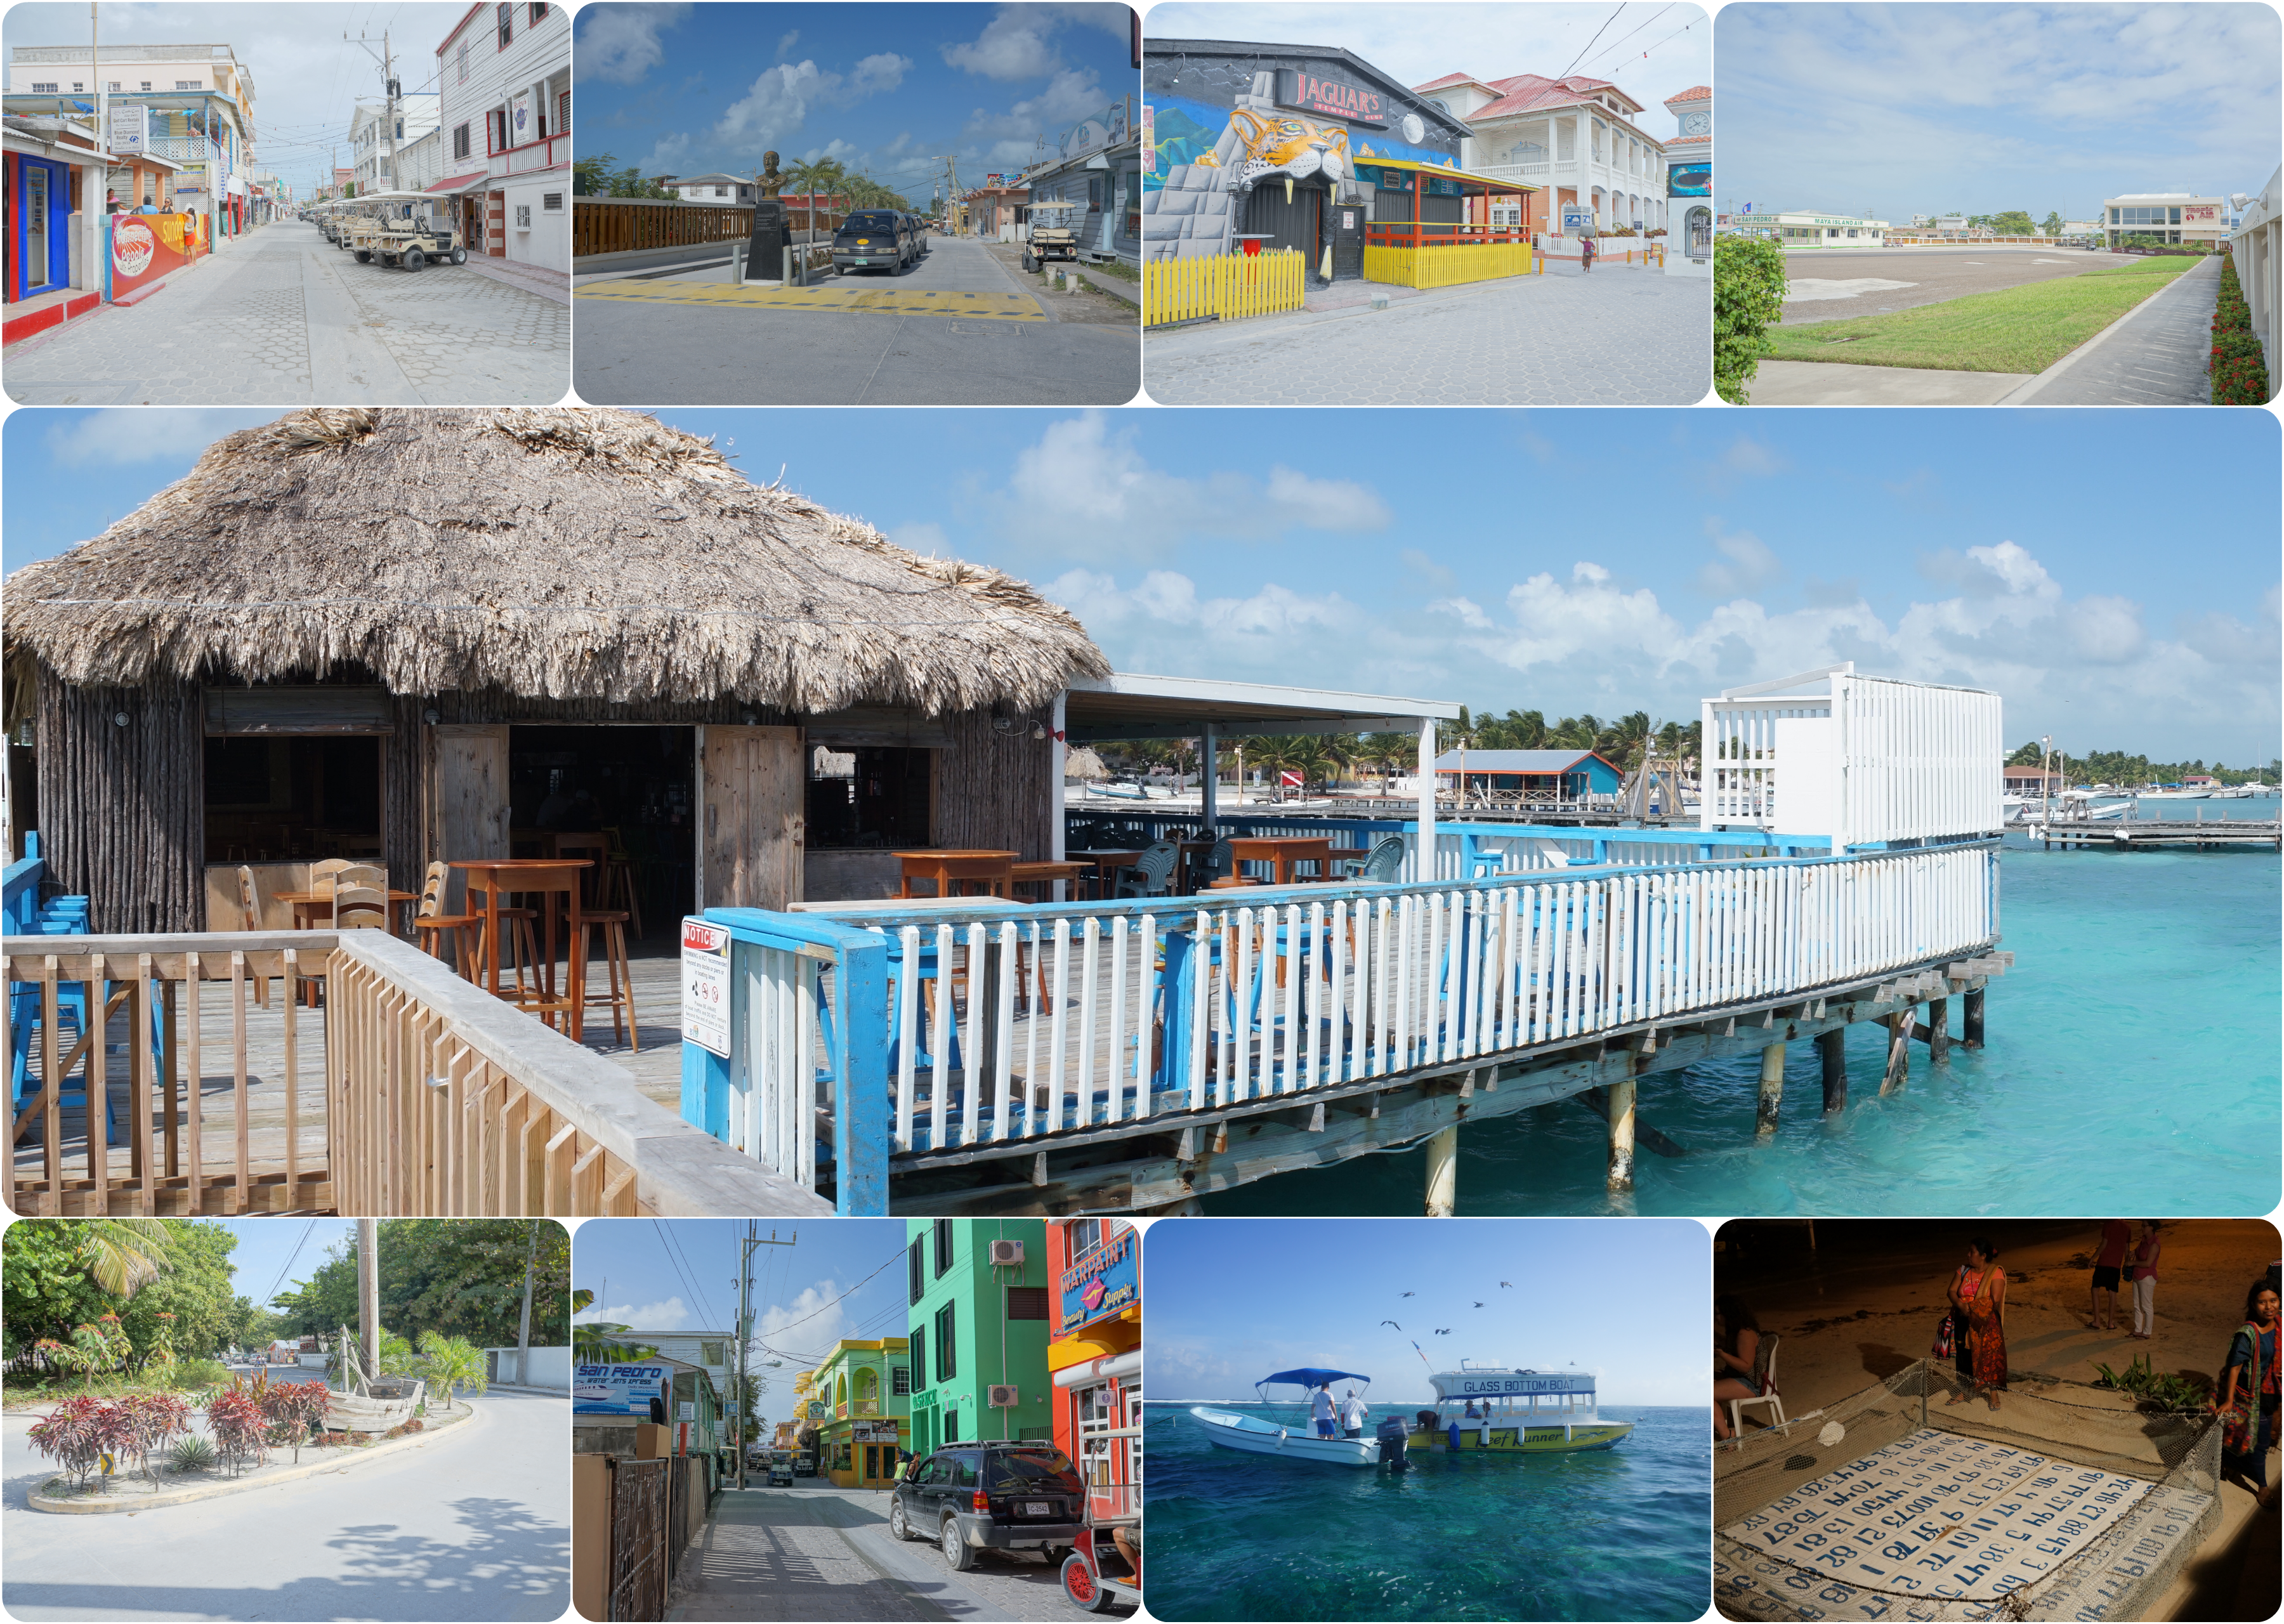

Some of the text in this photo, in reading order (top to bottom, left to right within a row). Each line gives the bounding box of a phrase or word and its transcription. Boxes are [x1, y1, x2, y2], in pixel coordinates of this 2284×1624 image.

[1296, 74, 1379, 114] JAGUAR'S
[515, 98, 526, 109] Ruby's
[1323, 103, 1355, 117] TEMPLE
[685, 925, 714, 946] NOTICE
[684, 950, 698, 959] SWIMMING
[708, 958, 727, 967] recommended
[698, 971, 707, 979] boating
[690, 1028, 699, 1037] BTB
[1061, 1234, 1127, 1294] WARPAINT
[1103, 1283, 1132, 1309] Supply
[1061, 1308, 1085, 1328] Beauty
[1464, 1380, 1575, 1392] GLASS BOTTOM BOAT
[1920, 1431, 1941, 1440] 74
[1920, 1445, 1945, 1455] 86
[1966, 1443, 1988, 1451] 14
[1991, 1449, 2018, 1459] 76
[1848, 1460, 1878, 1472] 99
[1897, 1456, 1926, 1467] 53
[1927, 1463, 1951, 1473] 16
[1973, 1459, 2000, 1470] 58
[2019, 1457, 2045, 1467] 95
[1823, 1472, 1854, 1485] 43
[1953, 1472, 1981, 1483] 93
[2001, 1465, 2028, 1478] 69
[2078, 1472, 2104, 1483] 90
[1797, 1482, 1828, 1496] 26
[1850, 1481, 1882, 1493] 70
[1982, 1478, 2010, 1491] 25
[2031, 1477, 2058, 1488] 96
[2108, 1479, 2137, 1491] 42
[1875, 1490, 1909, 1503] 44
[1931, 1484, 1960, 1497] 98
[2061, 1484, 2090, 1498] 79
[1769, 1496, 1801, 1513] 64
[1823, 1492, 1856, 1507] 49
[1905, 1496, 1939, 1514] 100
[1959, 1491, 1991, 1507] 33
[2044, 1496, 2073, 1512] 57
[2094, 1492, 2122, 1504] 46
[1852, 1500, 1885, 1516] 50
[1993, 1504, 2022, 1517] 97
[2078, 1505, 2106, 1520] 27
[1793, 1509, 1828, 1524] 75
[1880, 1510, 1916, 1528] 73
[1940, 1511, 1964, 1521] 9
[2023, 1512, 2054, 1527] 94
[1823, 1518, 1854, 1534] 13
[1971, 1518, 1998, 1531] 11
[2058, 1520, 2088, 1535] 88
[1762, 1522, 1799, 1545] 87
[1853, 1528, 1886, 1545] 21
[1910, 1522, 1945, 1542] 39
[2005, 1530, 2031, 1541] 5
[1793, 1534, 1827, 1552] 81
[1947, 1533, 1979, 1549] 61
[2037, 1537, 2070, 1555] 45
[2132, 1538, 2164, 1557] 60
[1815, 1545, 1858, 1568] 82
[1882, 1541, 1920, 1561] 78
[1979, 1543, 2014, 1562] 38
[1917, 1553, 1955, 1571] 72
[2020, 1559, 2048, 1571] 3
[1860, 1564, 1885, 1575] 1
[1953, 1564, 1990, 1586] 47
[1891, 1576, 1921, 1590] 2
[1818, 1583, 1857, 1604] 18
